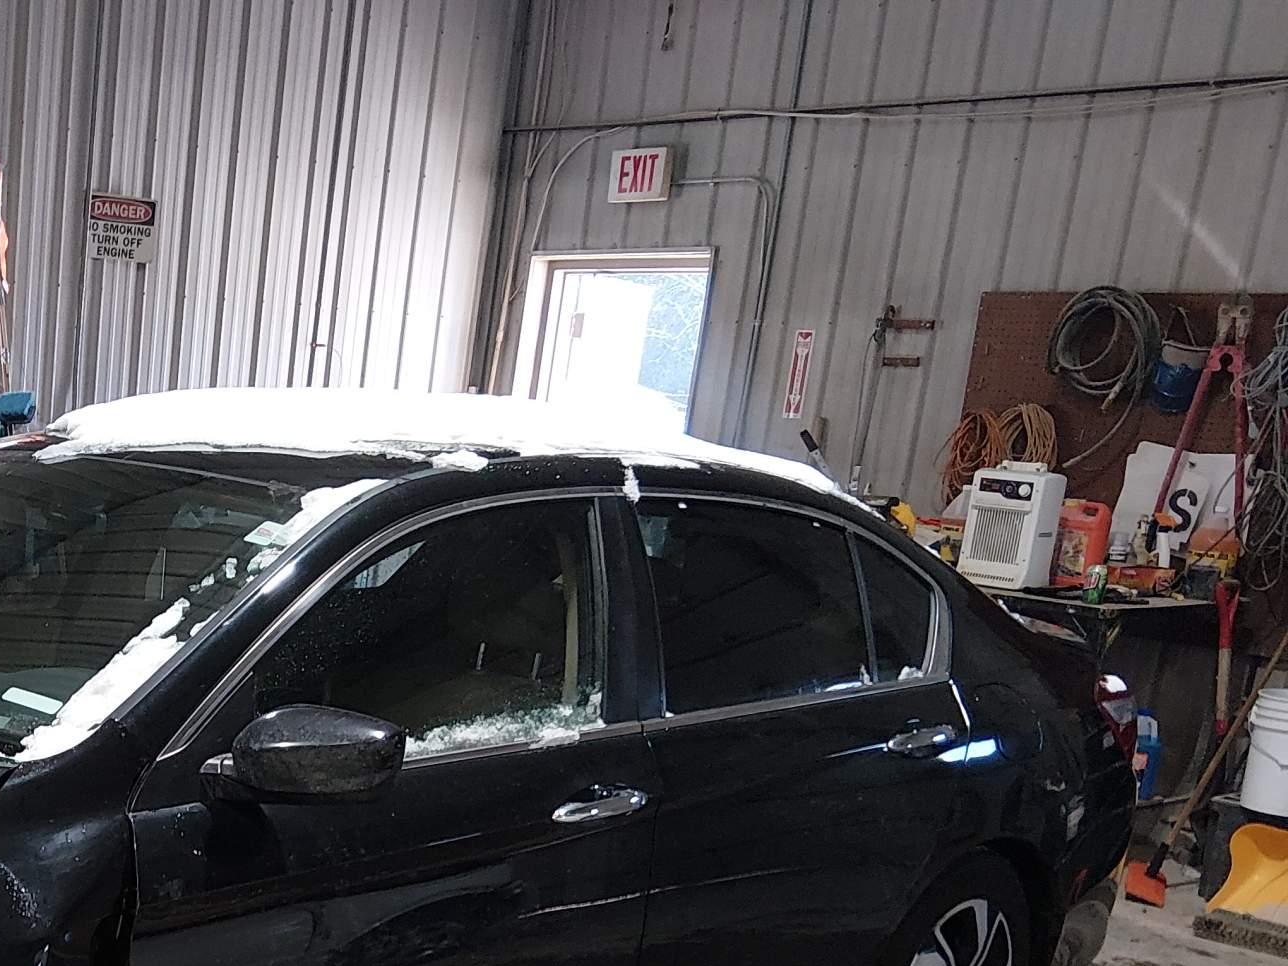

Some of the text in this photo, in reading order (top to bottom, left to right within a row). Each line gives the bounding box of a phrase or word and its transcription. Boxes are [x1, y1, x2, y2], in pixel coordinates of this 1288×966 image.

[617, 153, 659, 193] EXIT
[94, 201, 146, 219] DANGER
[103, 223, 151, 237] SMOKING
[91, 233, 143, 248] TURN OFF
[97, 245, 135, 259] ENGINE
[1169, 488, 1198, 532] S
